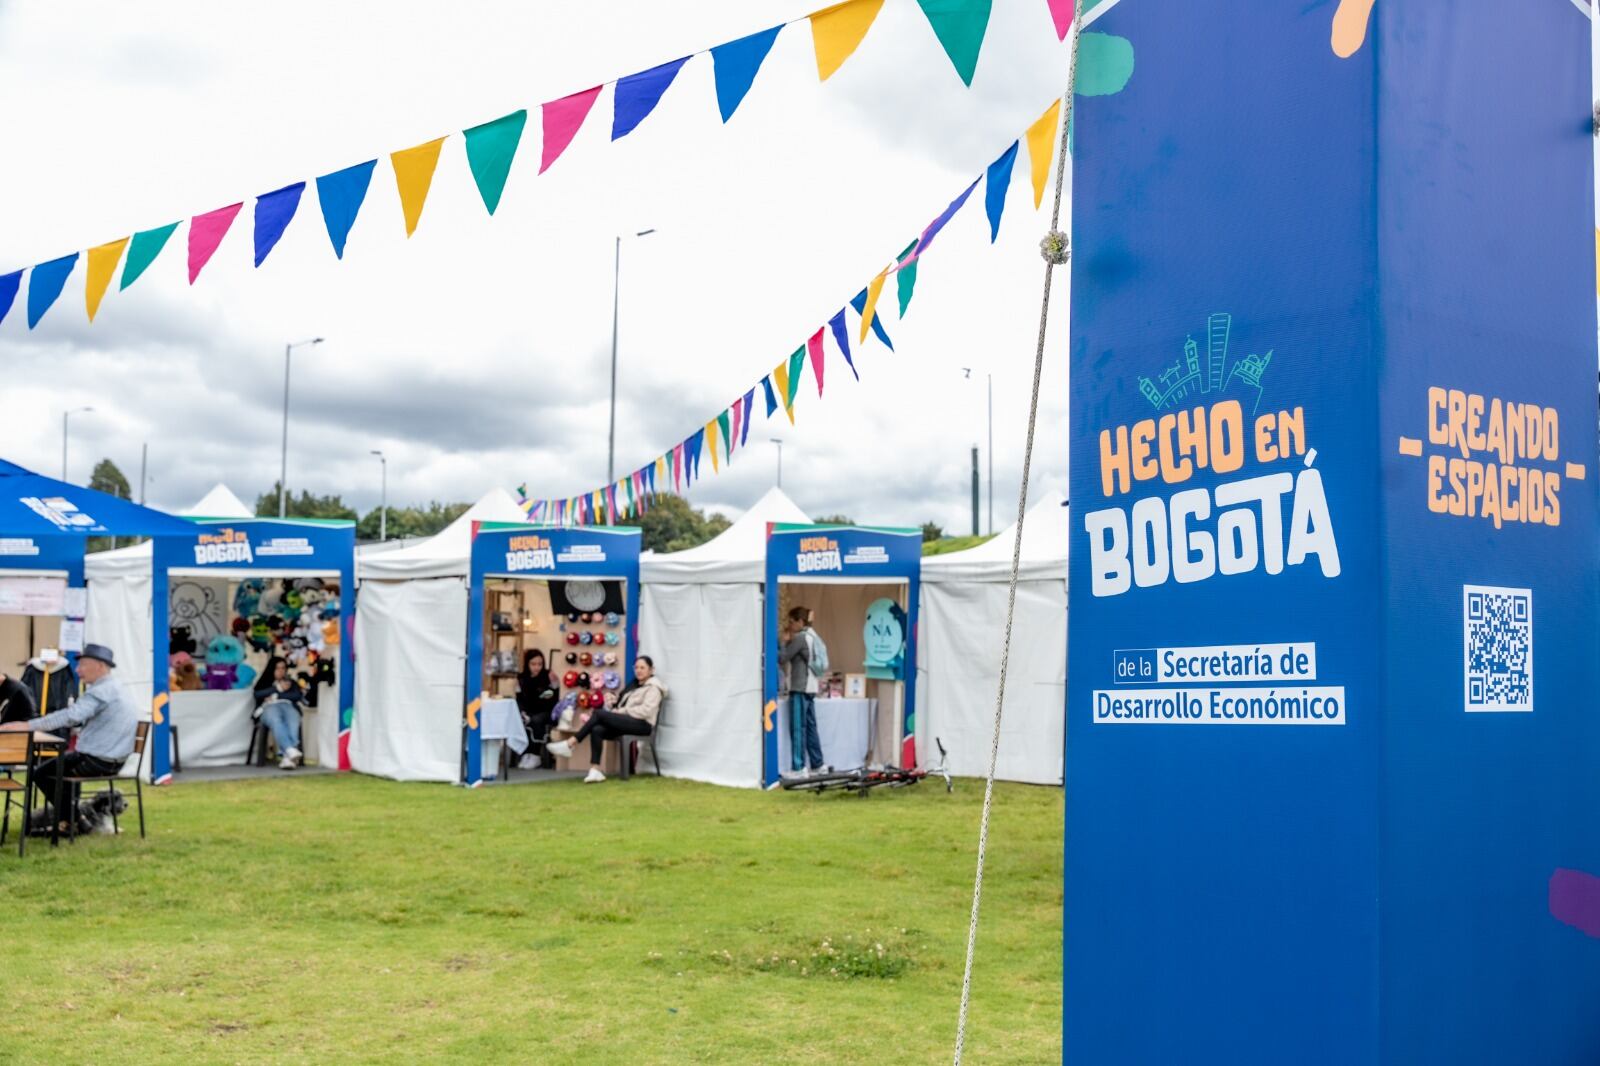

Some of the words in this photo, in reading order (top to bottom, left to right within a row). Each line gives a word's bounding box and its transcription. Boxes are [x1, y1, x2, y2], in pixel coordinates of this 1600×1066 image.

[1428, 386, 1558, 465] CREANDO
[1100, 400, 1244, 496] HECHO
[1255, 406, 1305, 462] EN
[1428, 455, 1560, 529] ESPACIOS
[1084, 447, 1341, 597] BOGOTÁ
[194, 539, 254, 564] BOGOTÁ
[505, 546, 555, 571] BOGOTÁ
[796, 548, 842, 572] BOGOTÁ
[1118, 657, 1135, 677] de
[1139, 657, 1152, 676] la
[1163, 648, 1273, 678] Secretaría
[1279, 646, 1309, 675] de
[1097, 692, 1201, 719] Desarrollo
[1209, 690, 1339, 719] Económico
